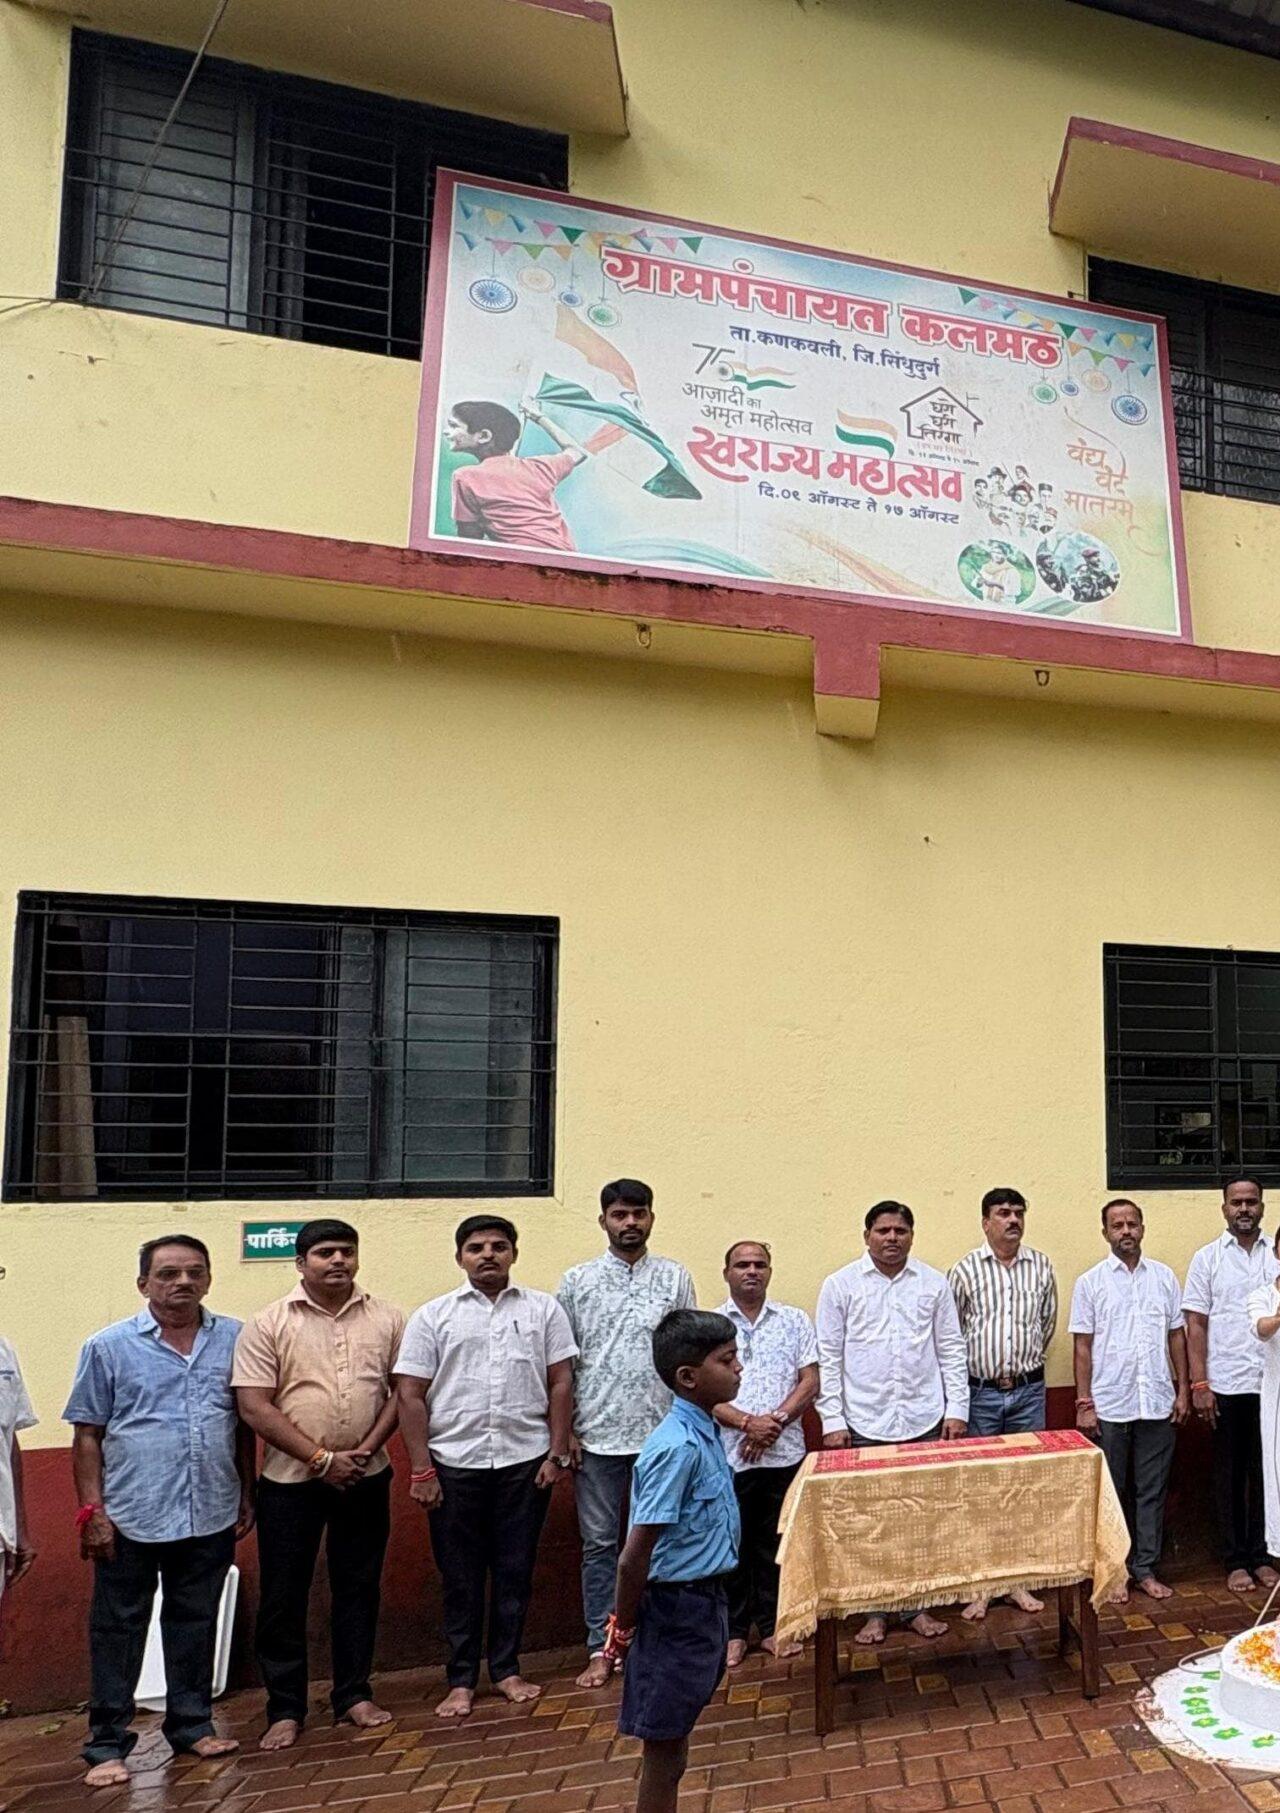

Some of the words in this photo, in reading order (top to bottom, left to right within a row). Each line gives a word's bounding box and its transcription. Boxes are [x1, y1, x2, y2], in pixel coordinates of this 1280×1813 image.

[601, 247, 889, 335] ग्रामपंचायत
[899, 305, 1062, 368] कलमठ
[701, 403, 743, 429] अमृत
[749, 410, 813, 435] महोत्सव
[747, 396, 761, 409] का
[687, 426, 824, 482] स्वराज्य
[809, 490, 860, 511] ऑगस्ट
[866, 495, 877, 513] ते
[884, 504, 903, 516] १७
[909, 505, 959, 525] ऑगस्ट
